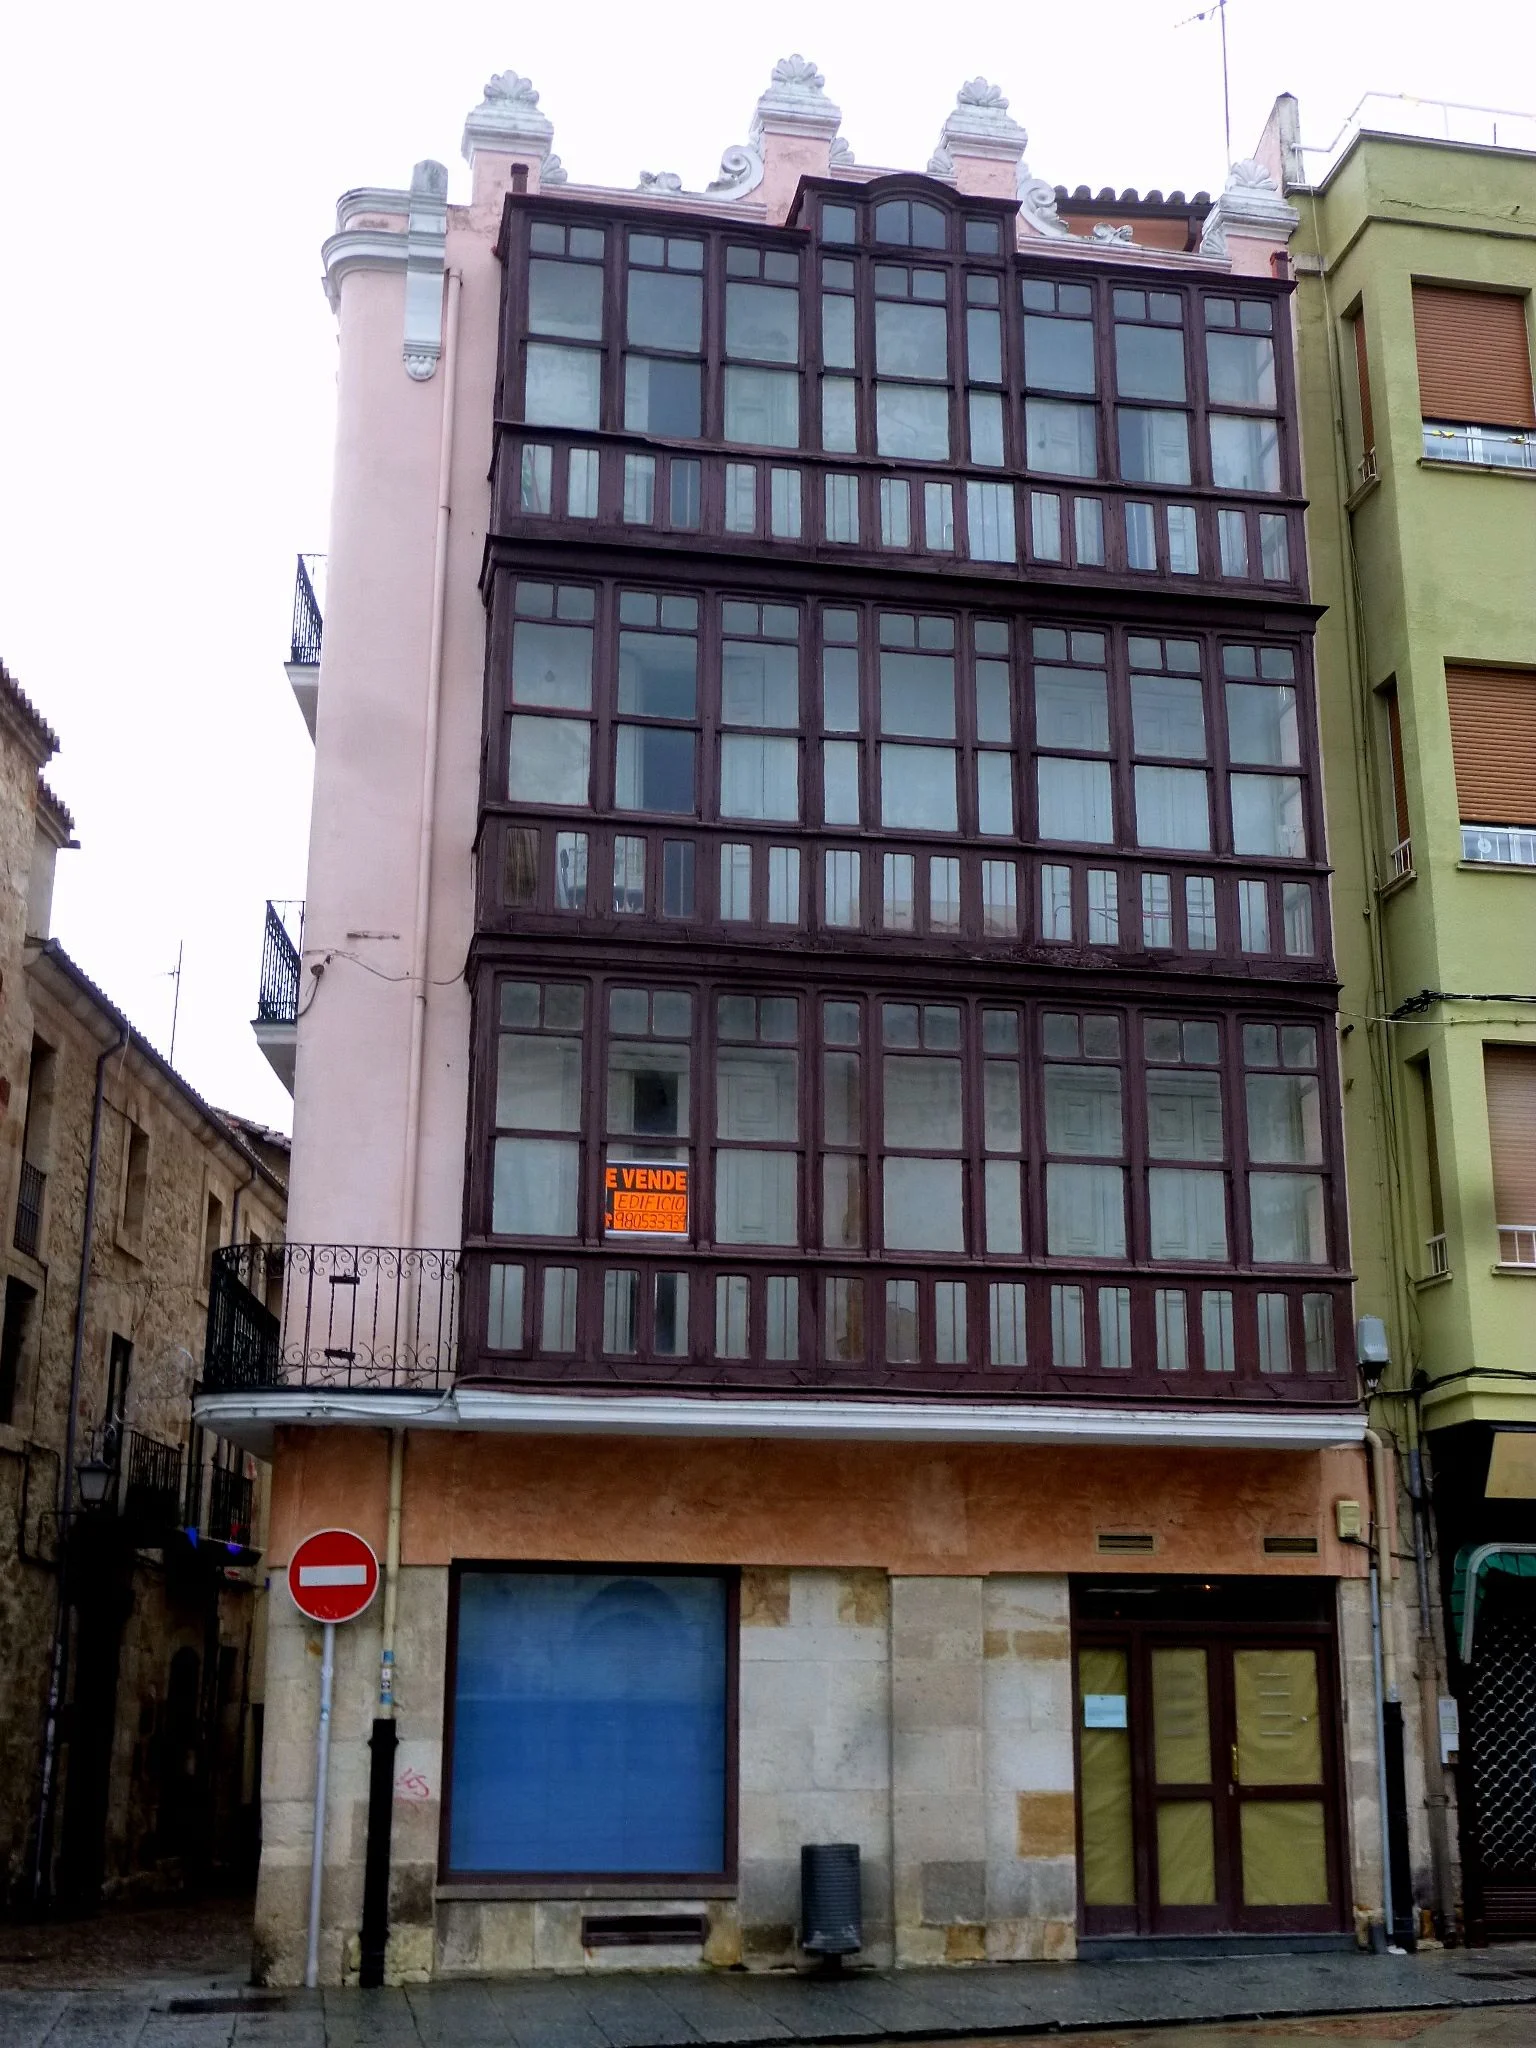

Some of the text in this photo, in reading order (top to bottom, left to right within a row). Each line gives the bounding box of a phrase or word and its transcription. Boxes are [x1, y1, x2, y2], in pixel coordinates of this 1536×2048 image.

[606, 1167, 687, 1191] E VENDE
[618, 1194, 685, 1211] EDIFICIO
